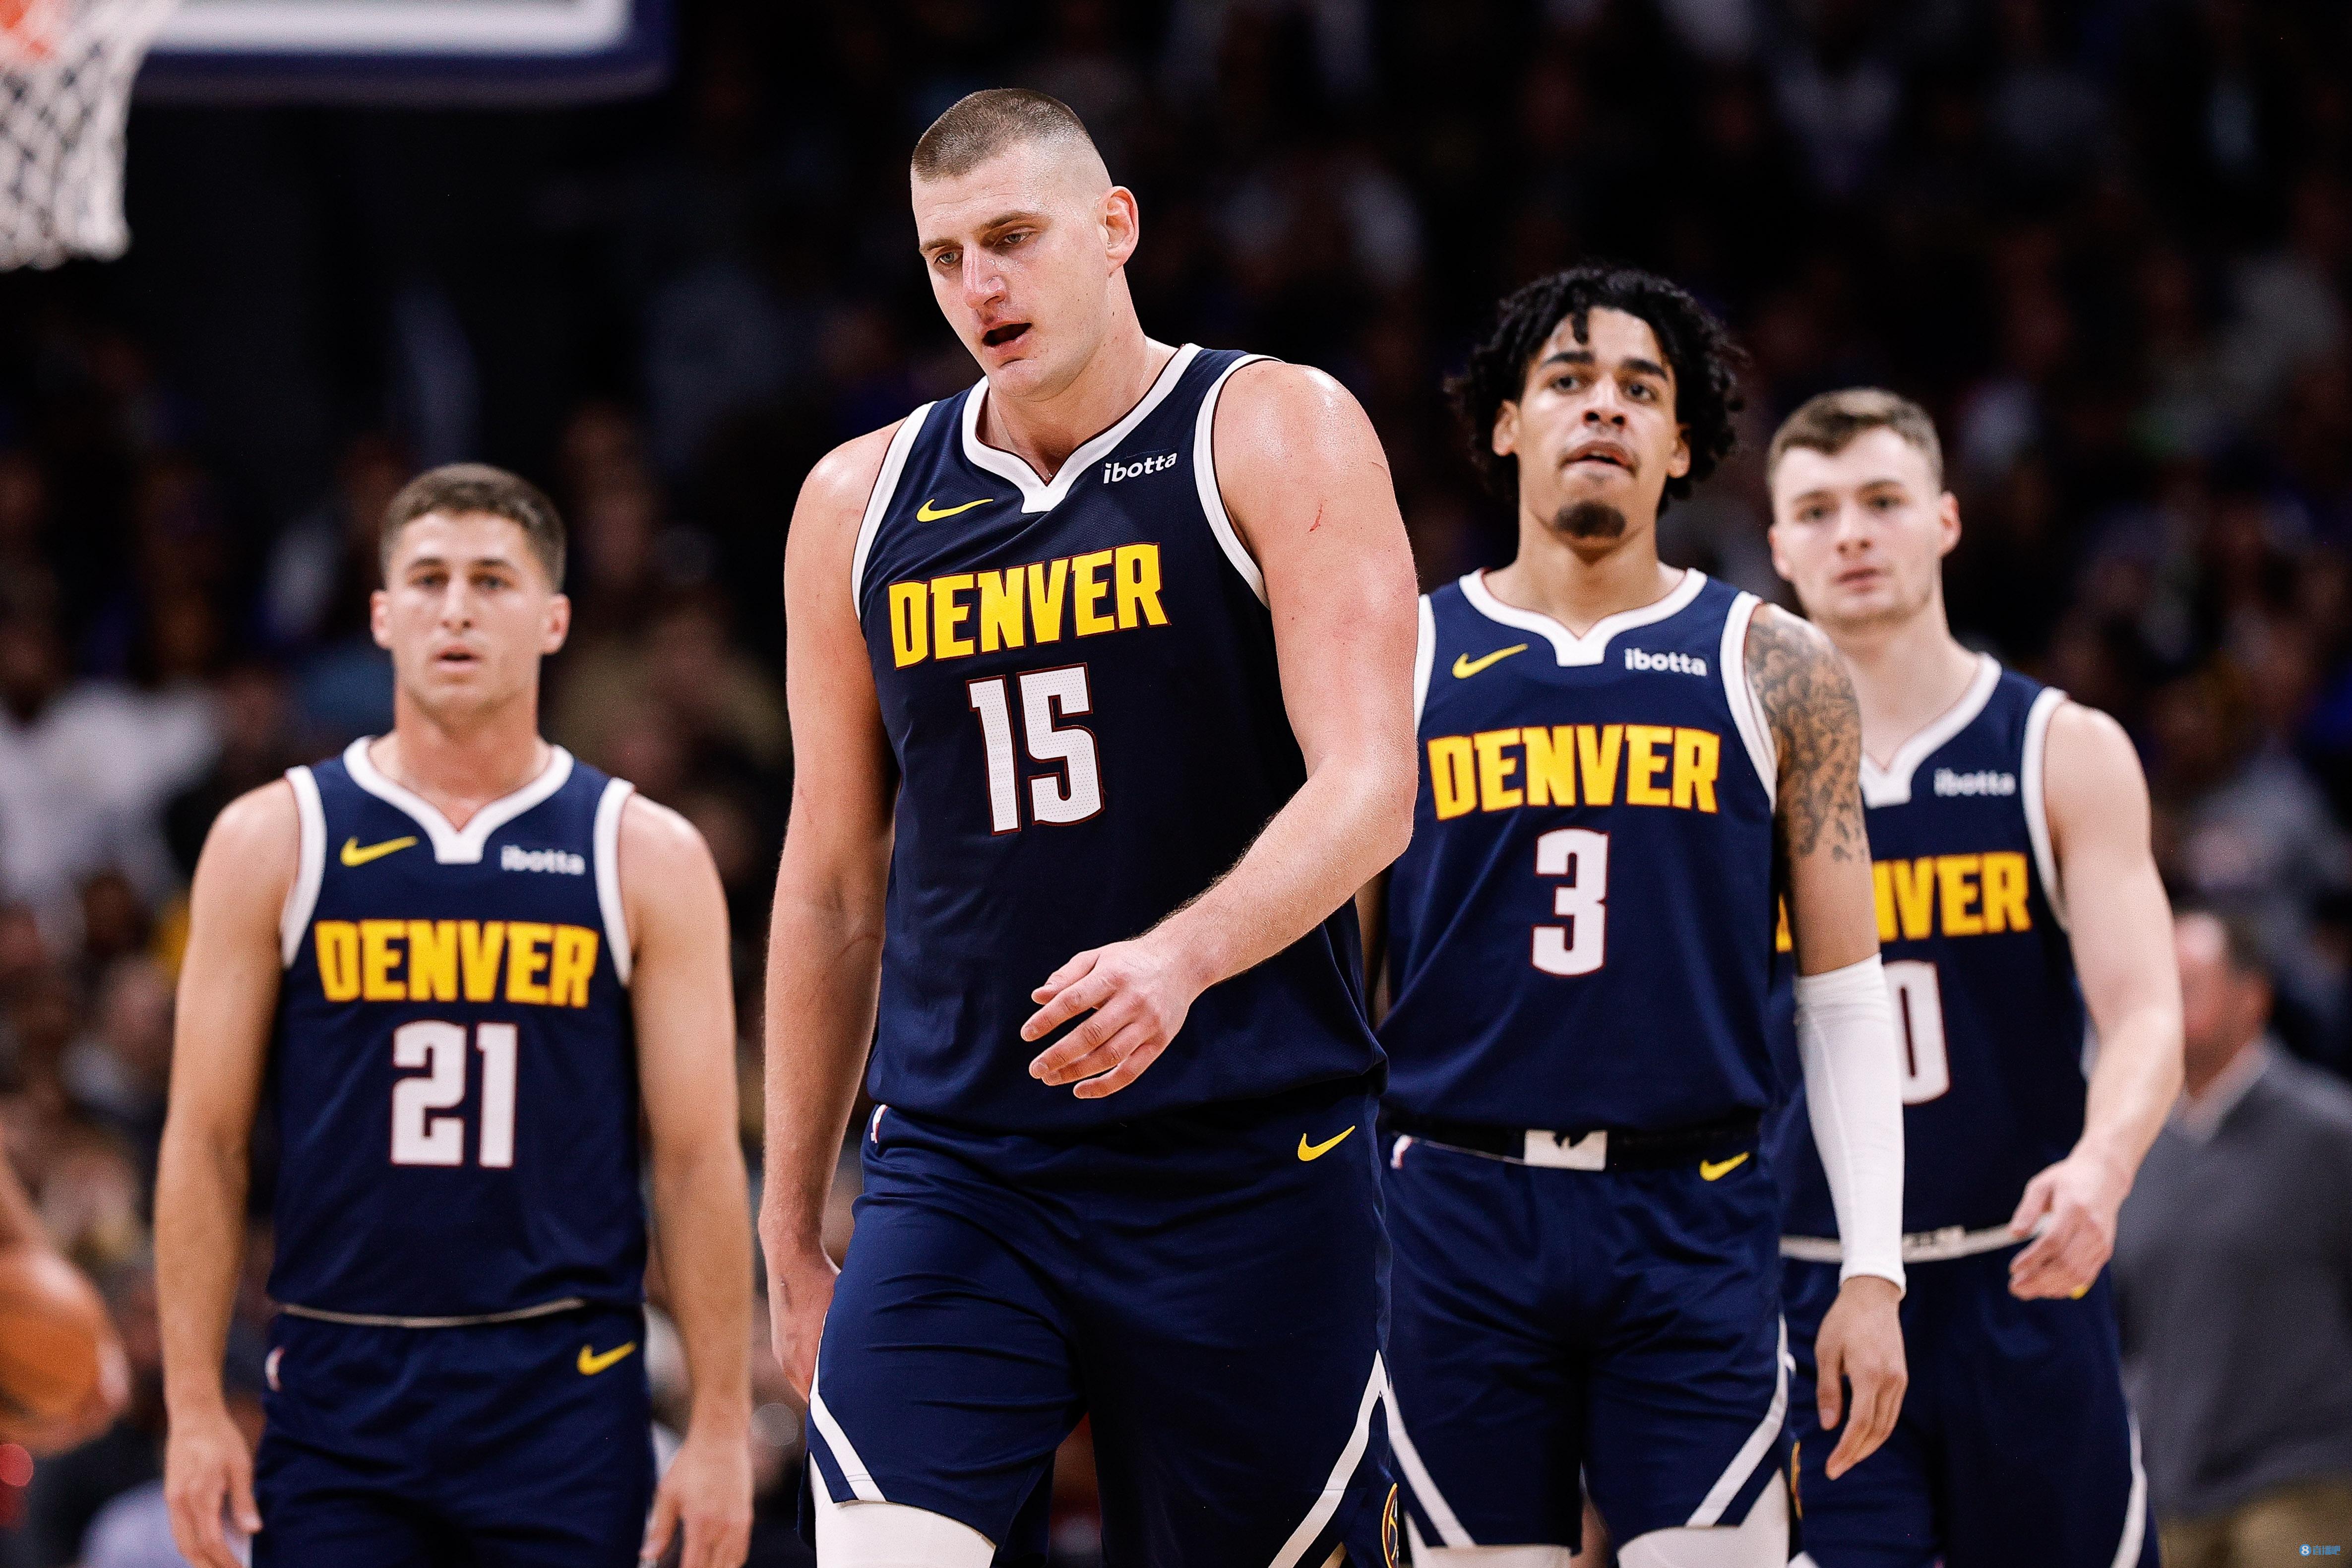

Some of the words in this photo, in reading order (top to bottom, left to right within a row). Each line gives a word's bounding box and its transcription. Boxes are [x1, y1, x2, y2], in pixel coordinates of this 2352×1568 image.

[1103, 450, 1177, 484] ibotta
[887, 542, 1172, 670] DENVER
[1624, 648, 1708, 677] ibotta
[966, 662, 1105, 835] 15
[1427, 724, 1721, 821] DENVER
[313, 918, 600, 1009] DENVER
[1531, 826, 1610, 978] 3
[390, 1018, 518, 1169] 21
[1882, 958, 1951, 1106] 0
